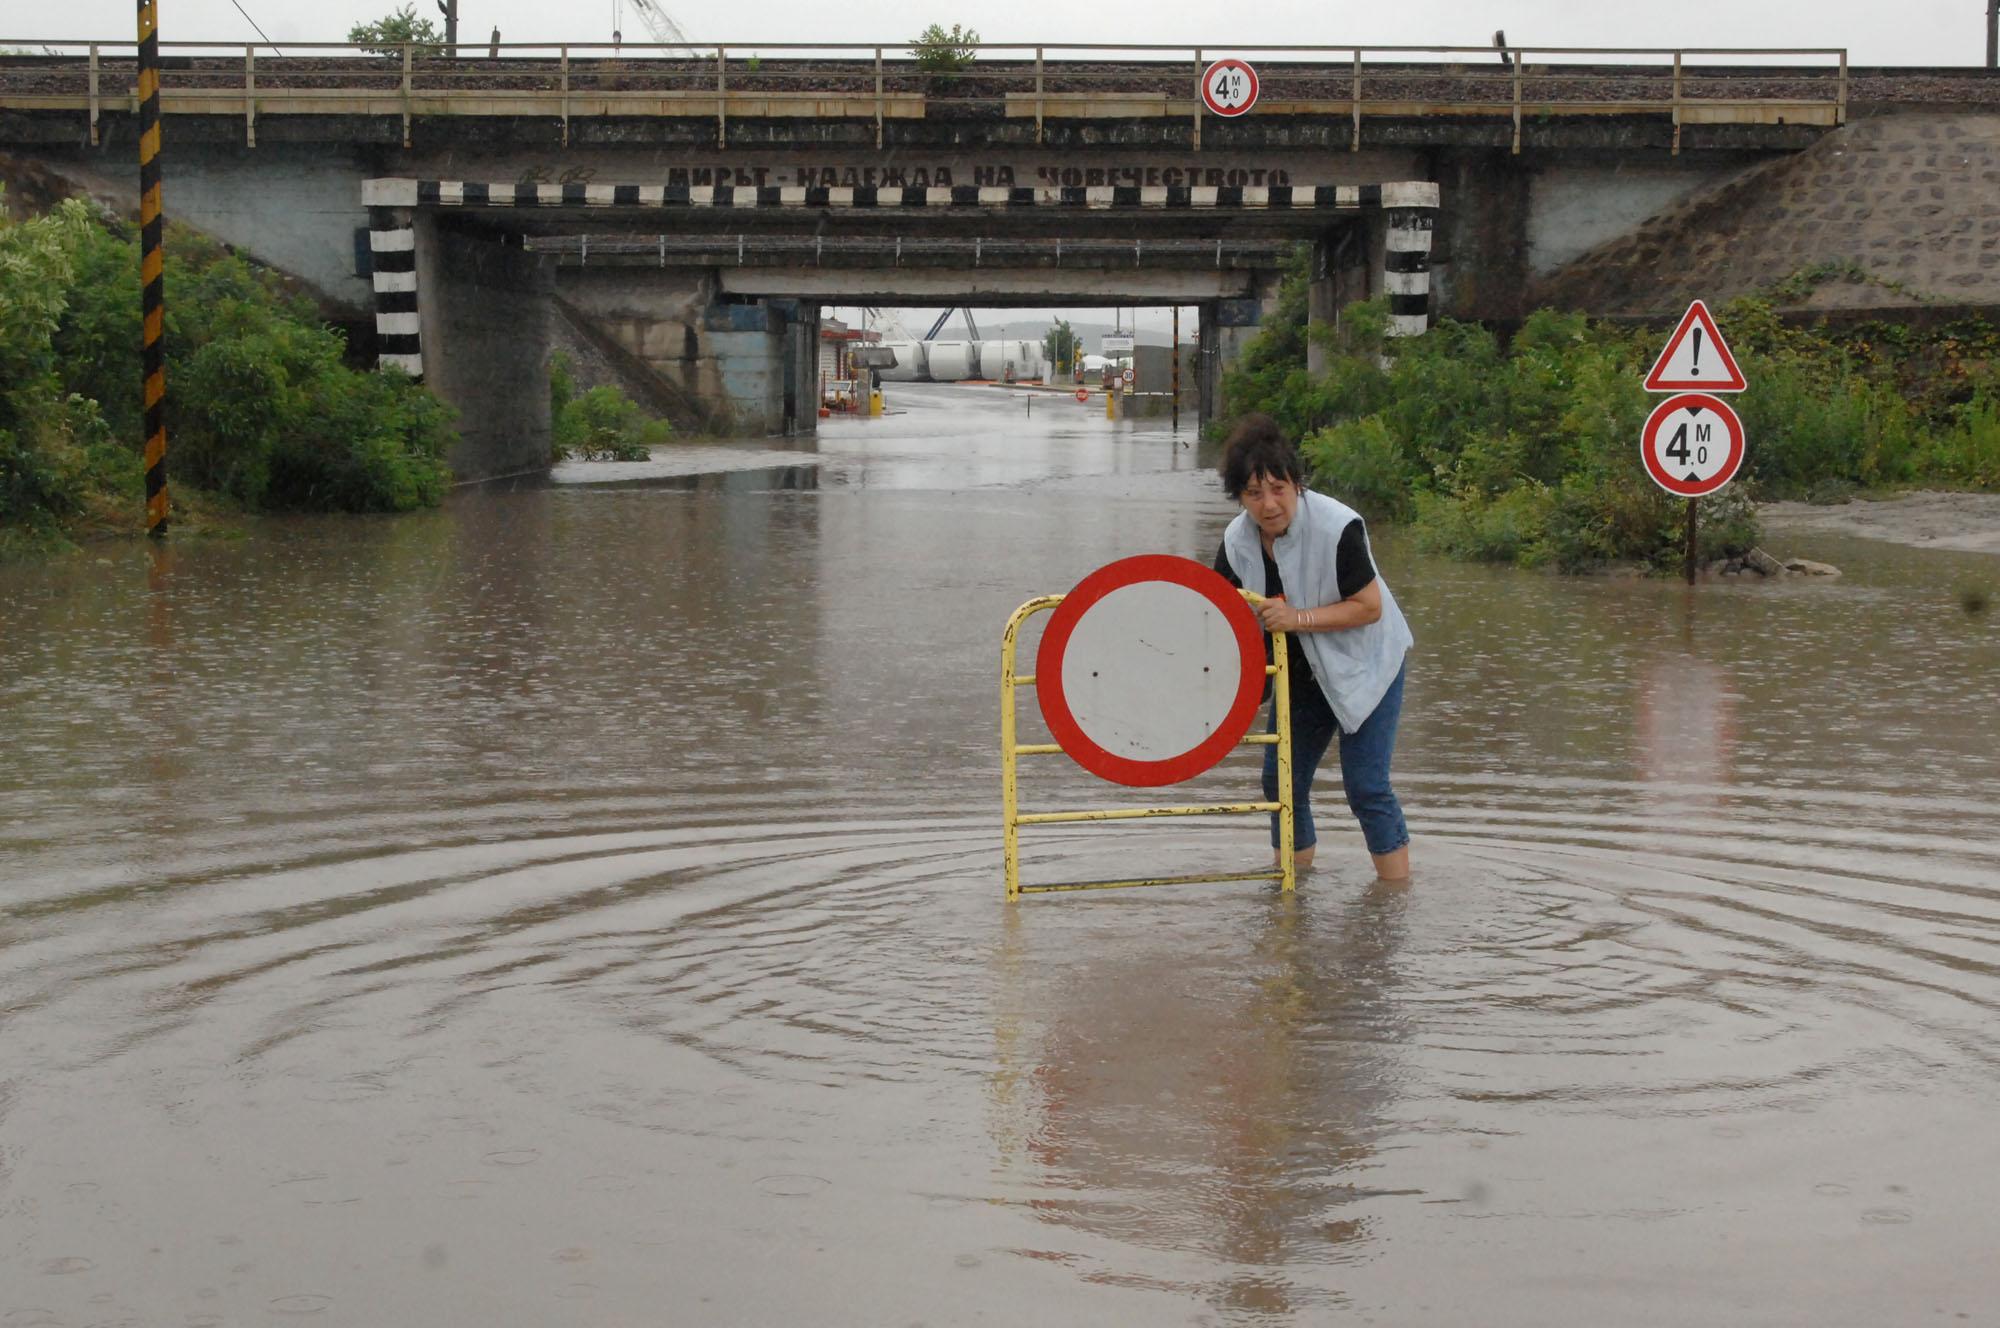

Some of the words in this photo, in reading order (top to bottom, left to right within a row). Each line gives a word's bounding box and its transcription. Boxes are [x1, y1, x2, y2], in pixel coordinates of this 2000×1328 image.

[797, 167, 953, 188] НАДЕЖДА
[974, 166, 1016, 187] НА
[1037, 166, 1289, 187] ЧОВЕЧЕСТВОТО
